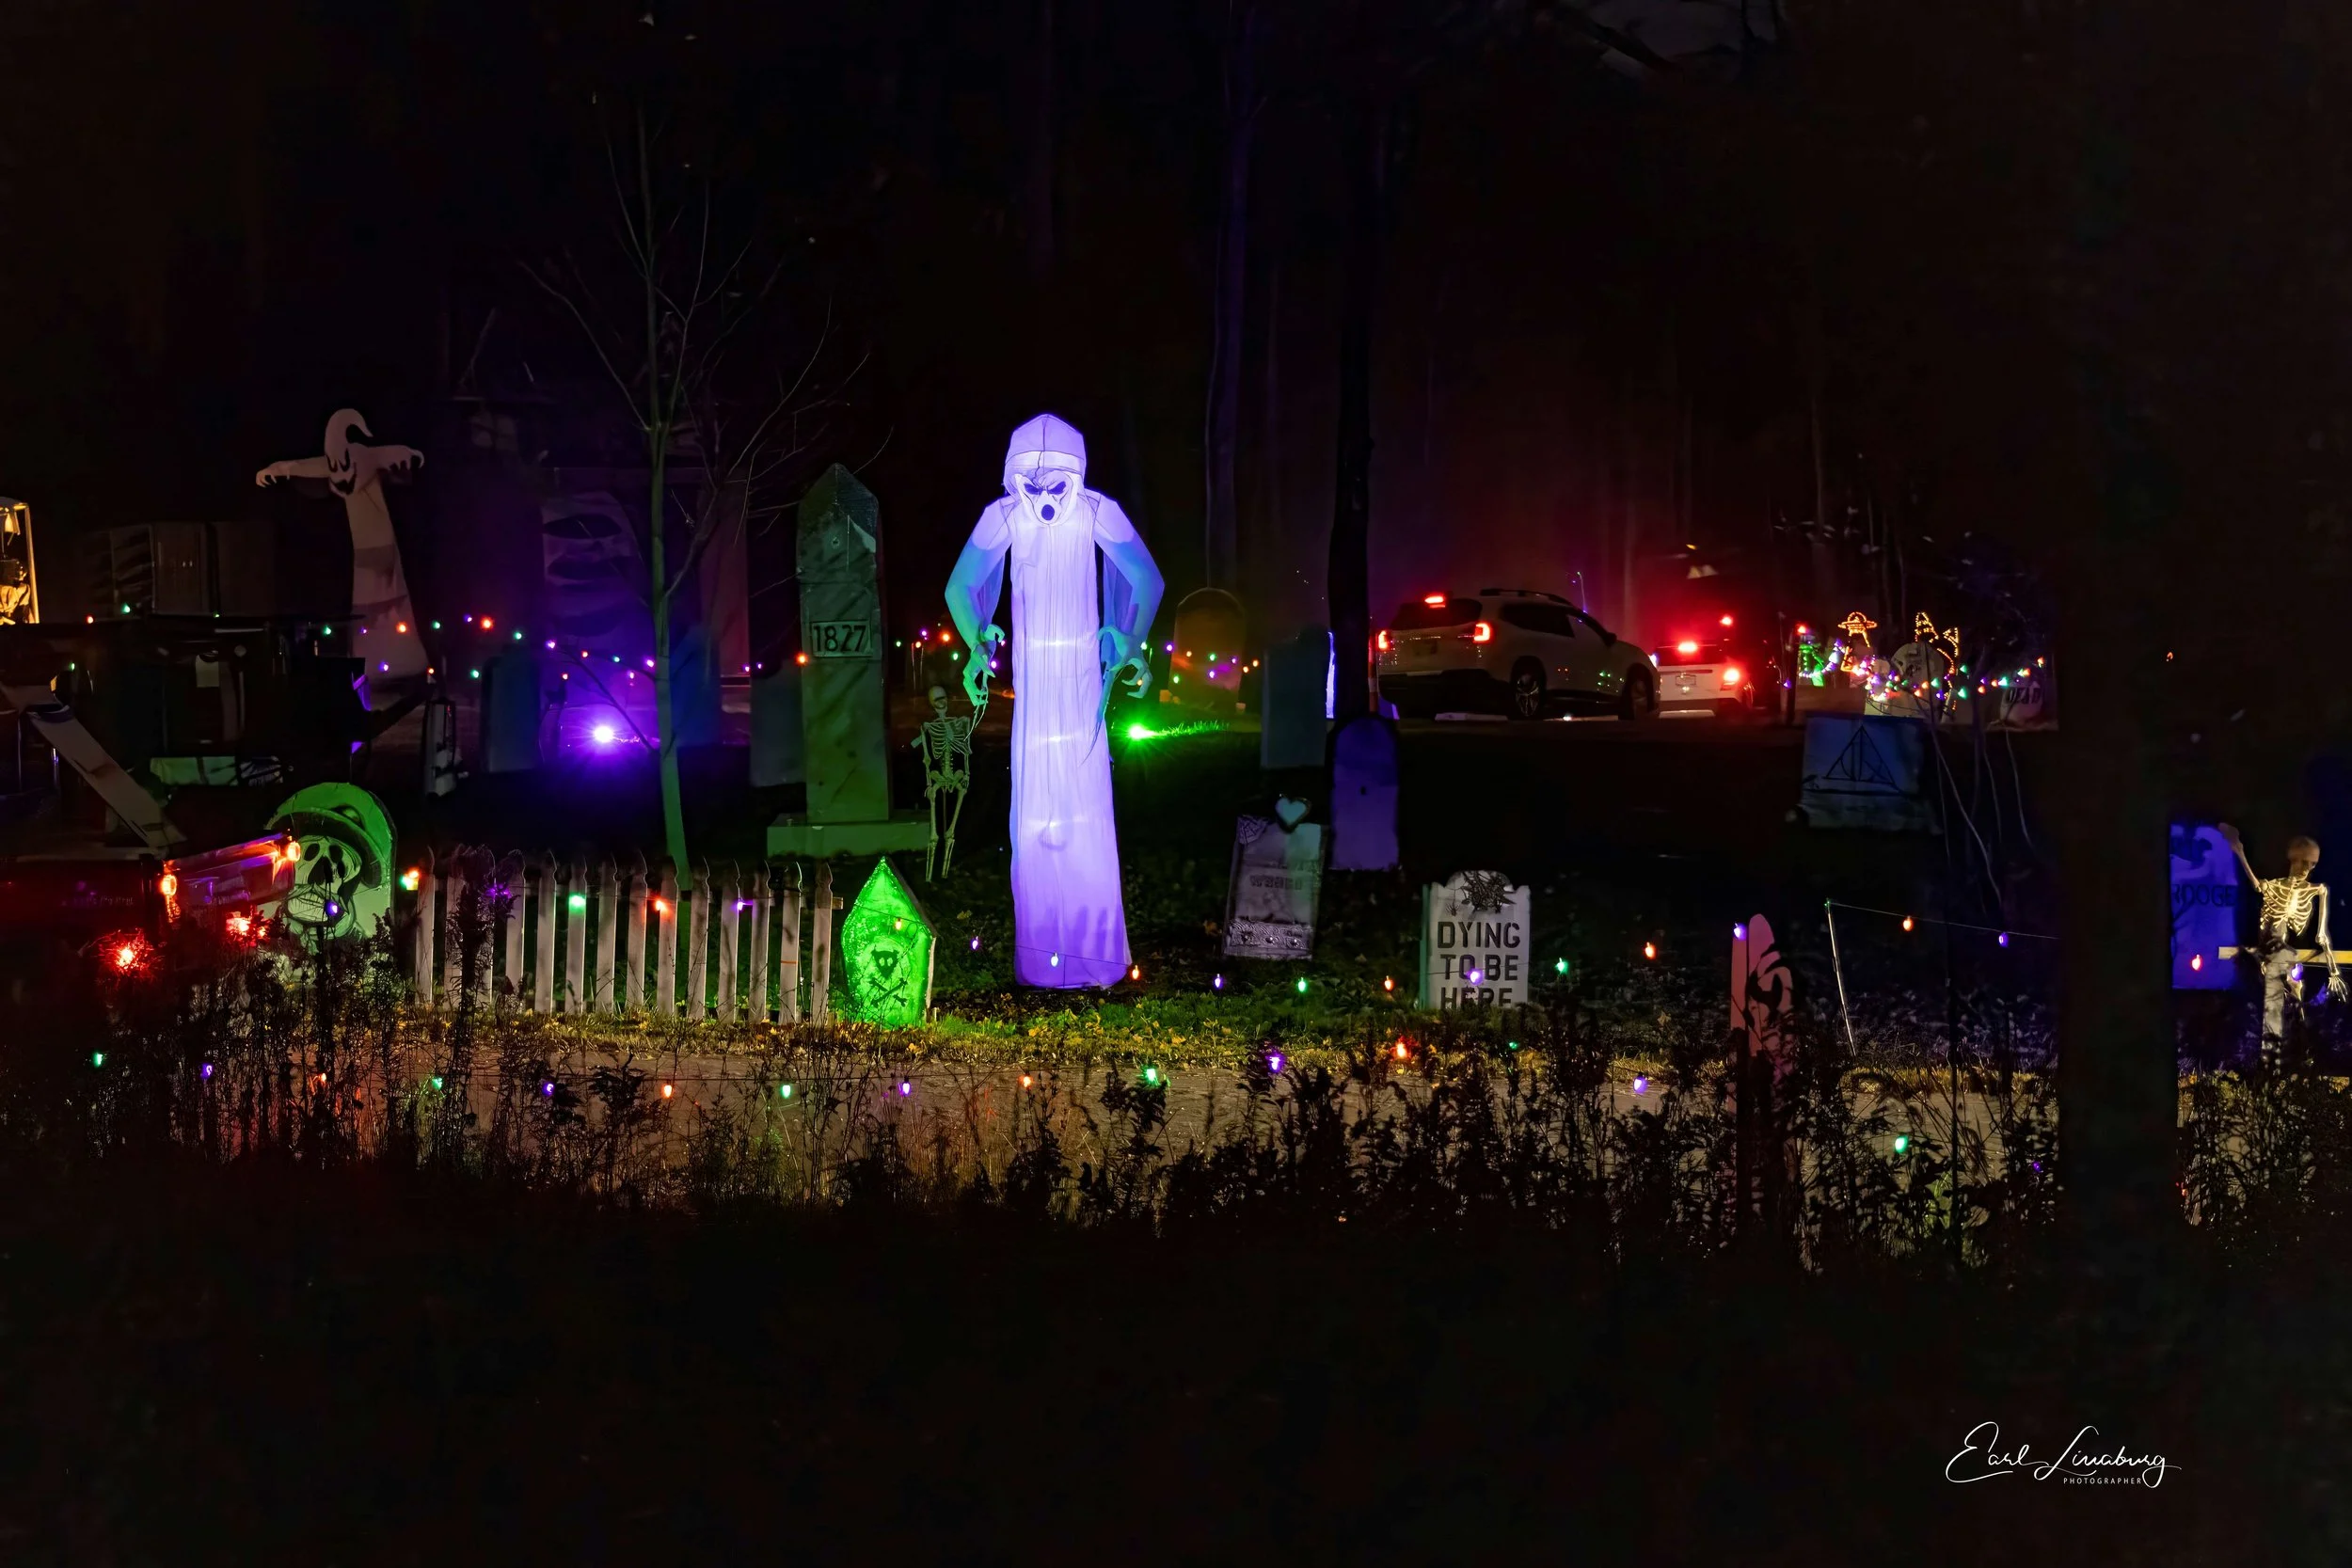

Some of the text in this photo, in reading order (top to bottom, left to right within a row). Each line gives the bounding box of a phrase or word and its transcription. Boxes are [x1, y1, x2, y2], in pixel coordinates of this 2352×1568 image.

[814, 625, 866, 652] 1827
[1438, 921, 1520, 948] DYING
[1440, 954, 1518, 981] TO BE
[1440, 987, 1513, 1010] HERE
